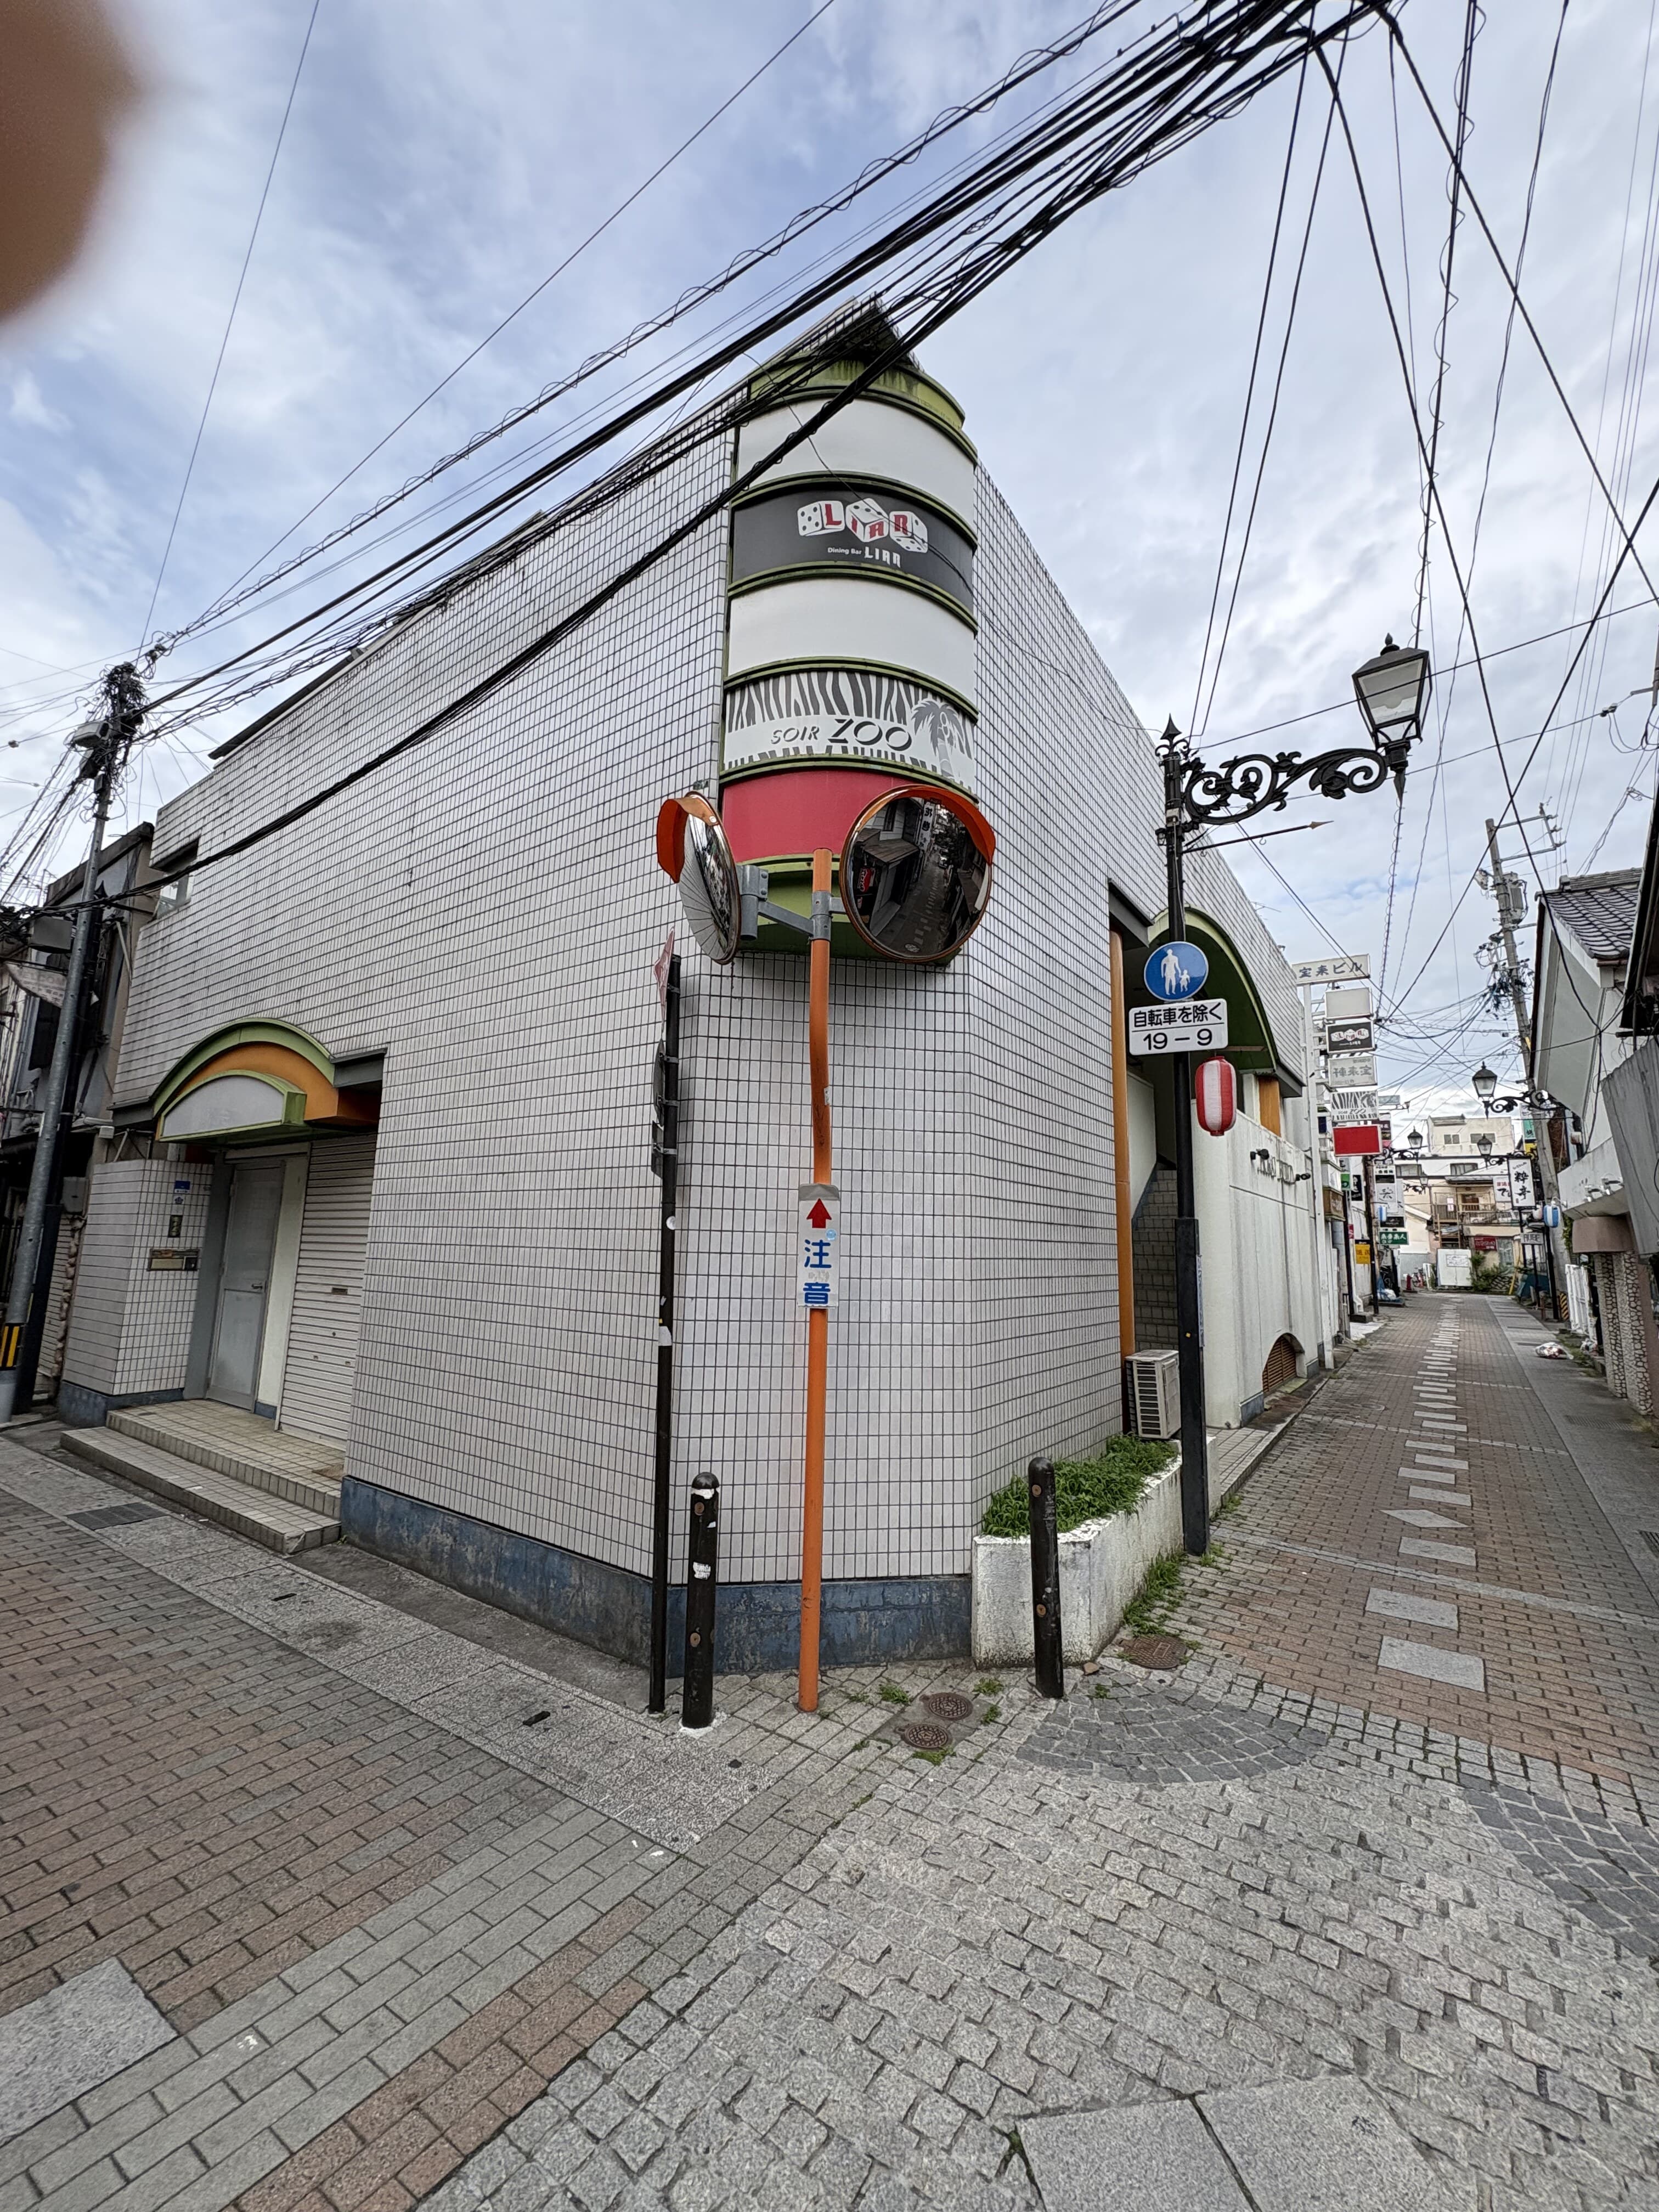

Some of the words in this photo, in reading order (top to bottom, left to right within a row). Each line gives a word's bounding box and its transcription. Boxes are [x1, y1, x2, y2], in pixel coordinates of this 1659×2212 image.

[825, 504, 909, 539] LIAR
[770, 725, 820, 744] SOIR
[828, 718, 912, 751] ZOO
[1299, 962, 1363, 978] 宝来ビル
[1133, 1002, 1223, 1028] 自転車を除く
